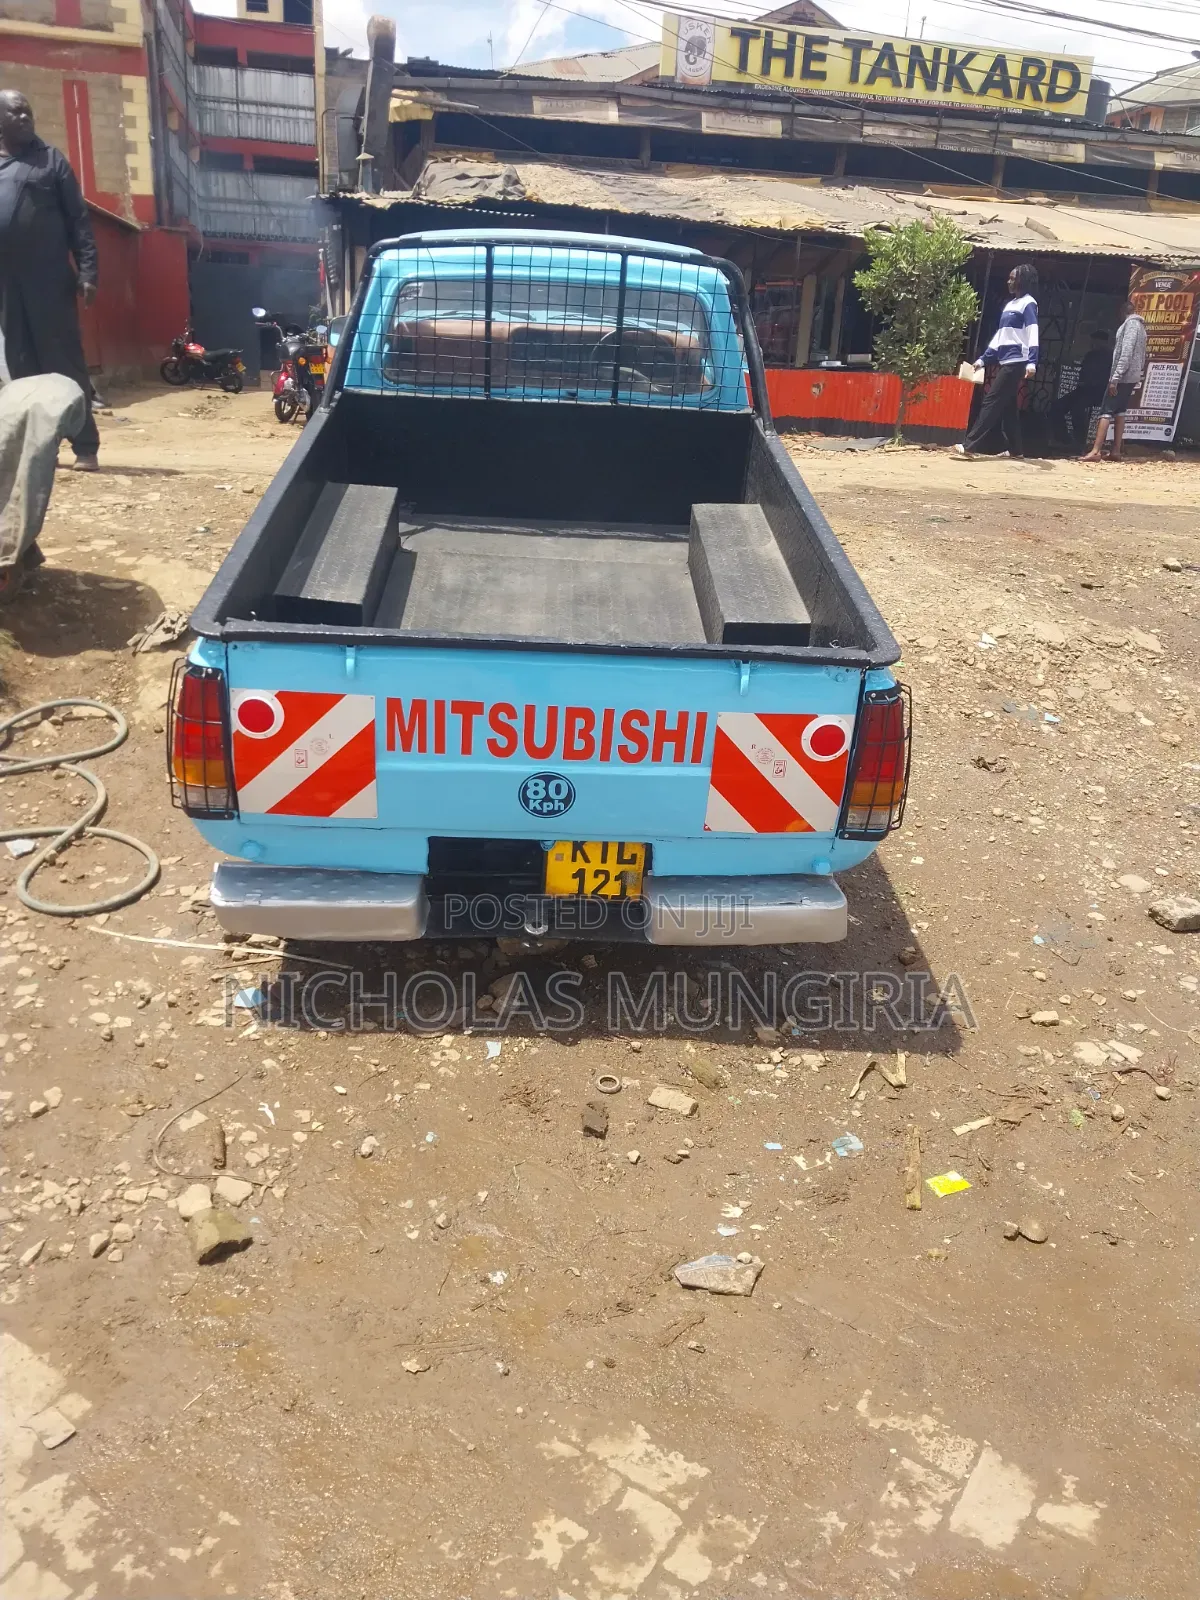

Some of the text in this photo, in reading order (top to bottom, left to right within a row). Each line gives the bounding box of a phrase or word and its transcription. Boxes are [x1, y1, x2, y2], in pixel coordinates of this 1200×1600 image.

[730, 27, 1082, 104] THE TANKARD
[1173, 152, 1200, 161] TUSK
[1155, 294, 1188, 311] POOL
[386, 696, 708, 764] MITSUBISHI
[526, 779, 569, 800] 80
[529, 799, 565, 813] Kph
[569, 867, 632, 900] 121
